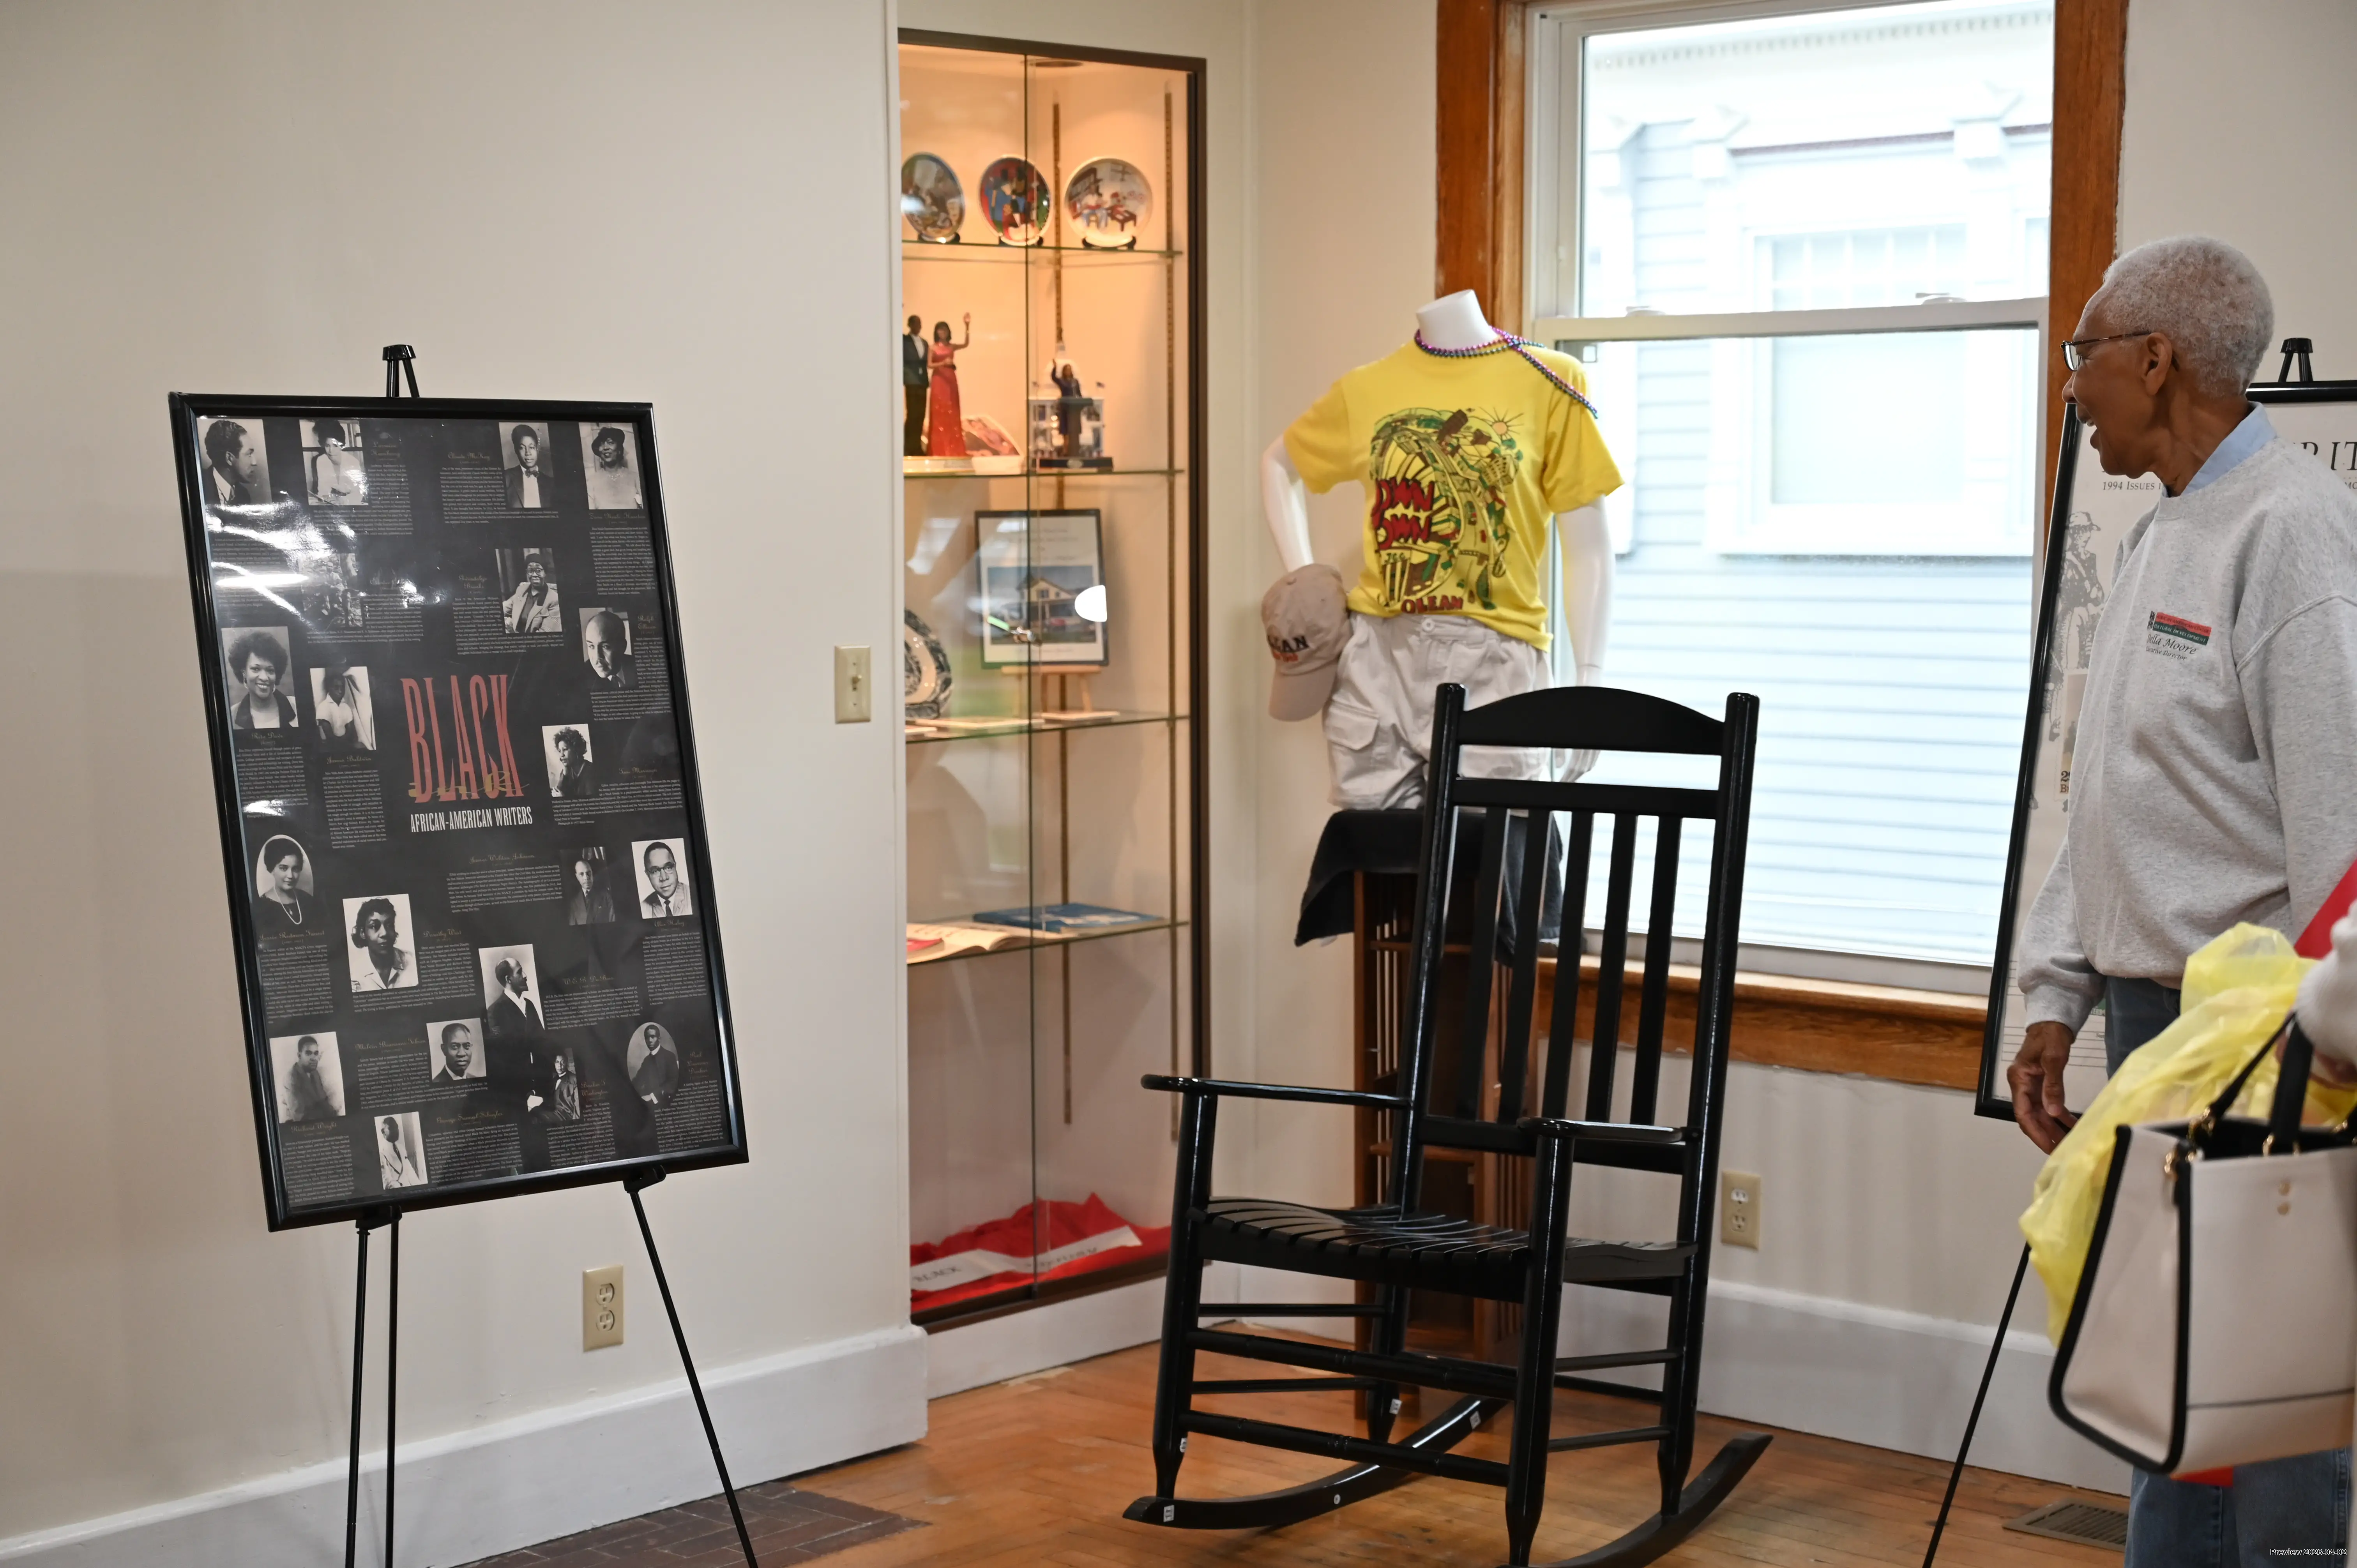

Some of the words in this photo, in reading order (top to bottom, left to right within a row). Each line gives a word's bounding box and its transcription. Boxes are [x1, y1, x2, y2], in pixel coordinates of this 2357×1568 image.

[2103, 481, 2123, 490] 1994
[1401, 595, 1464, 613] OLEAN
[2173, 628, 2206, 643] DEVELOPMENT
[2163, 638, 2197, 655] Moore
[2163, 650, 2187, 661] Director
[399, 675, 524, 803] BLACK
[410, 808, 493, 833] AFRICAN-AMERICAN
[494, 806, 533, 827] WRITERS
